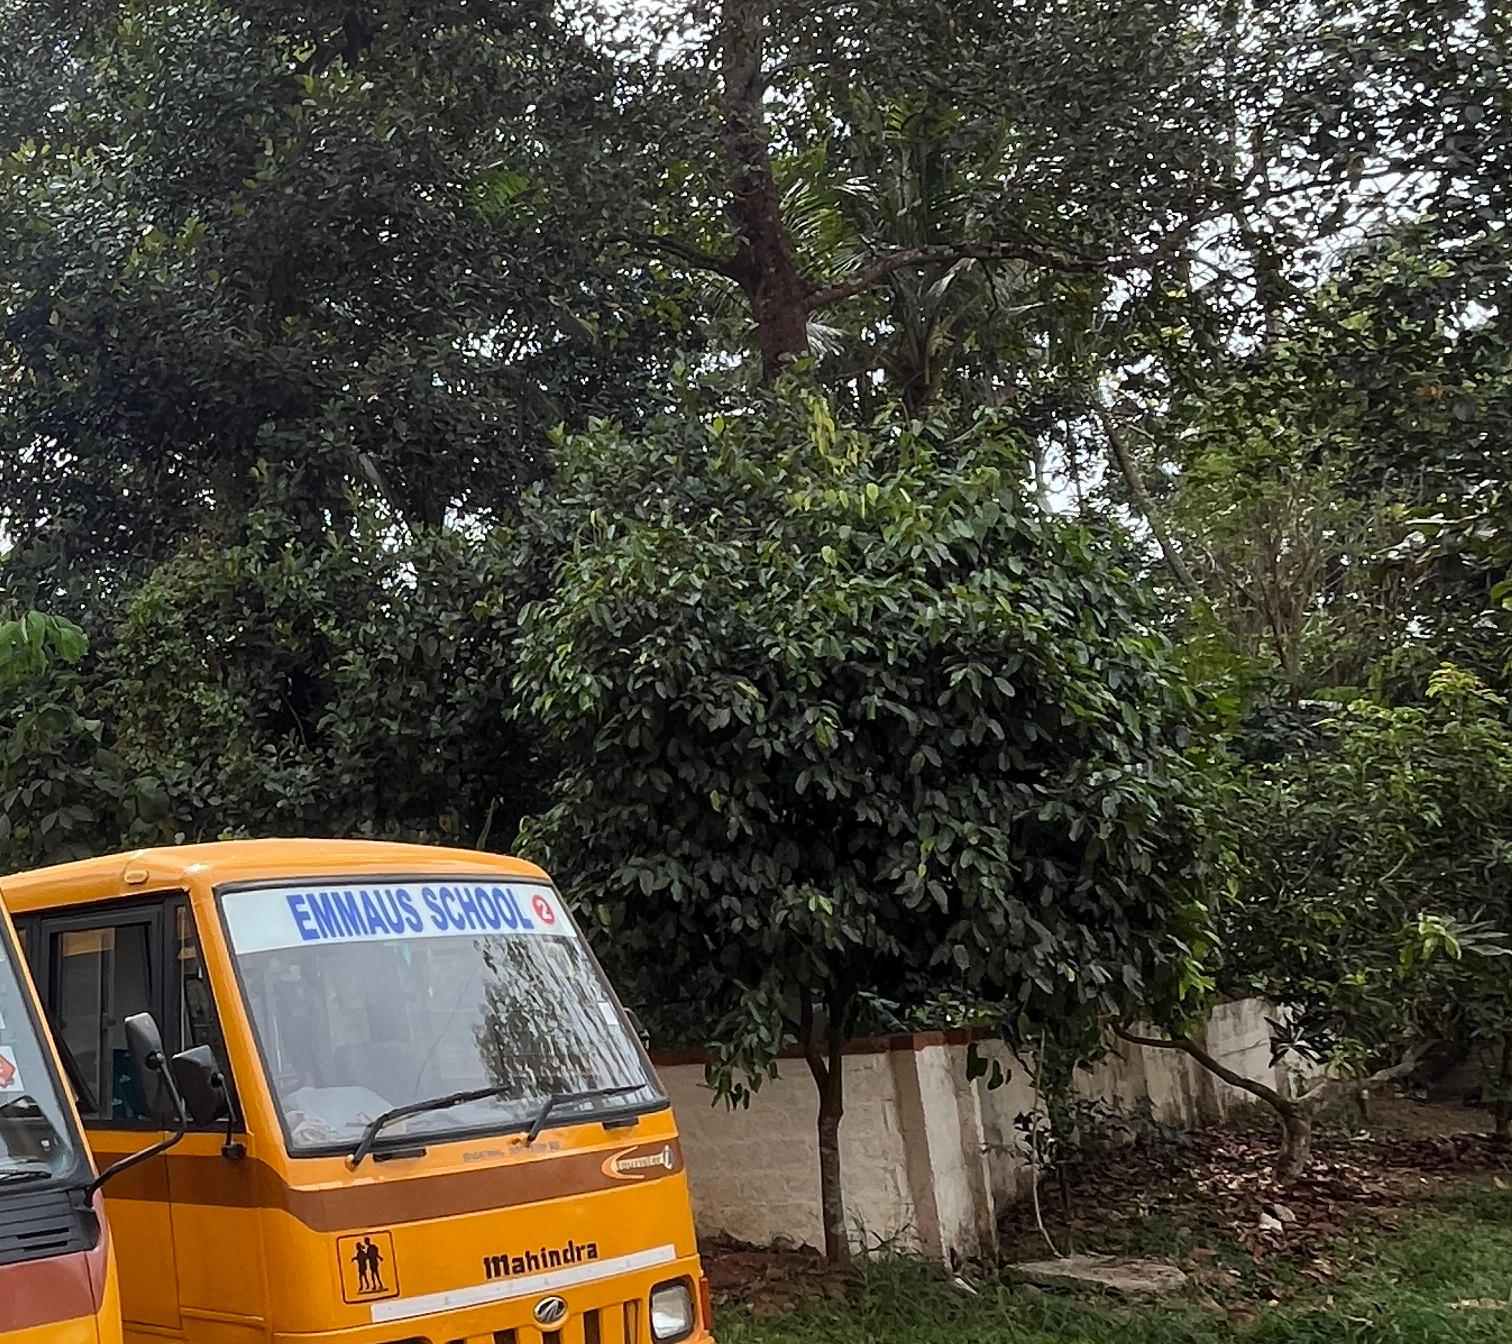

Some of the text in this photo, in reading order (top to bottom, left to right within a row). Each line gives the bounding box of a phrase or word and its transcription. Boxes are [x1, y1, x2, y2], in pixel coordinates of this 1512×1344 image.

[286, 886, 535, 941] EMMAUS SCHOOL
[536, 899, 553, 920] 2
[483, 1239, 599, 1280] Mahindra
